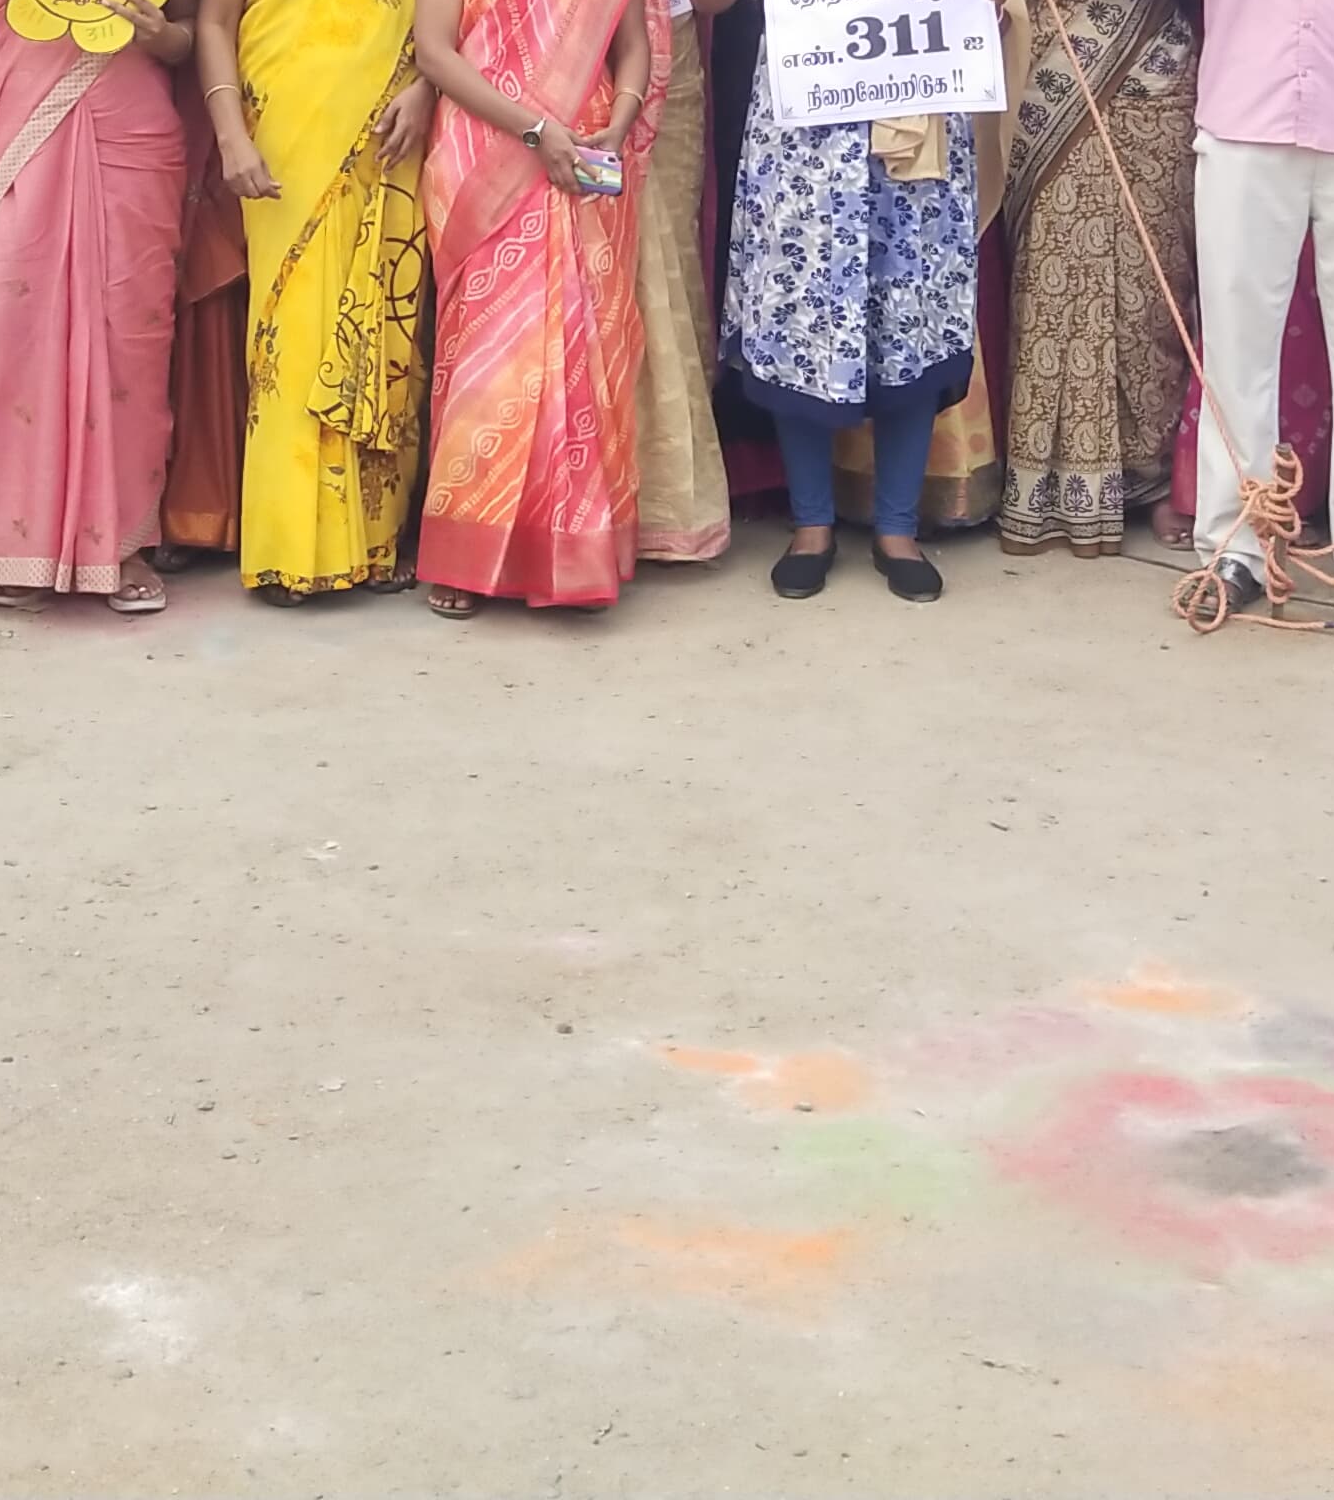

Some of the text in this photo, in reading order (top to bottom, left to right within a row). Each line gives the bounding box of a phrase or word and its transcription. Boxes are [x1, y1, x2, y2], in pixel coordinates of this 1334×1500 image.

[85, 23, 114, 42] 311
[845, 10, 951, 61] 311
[963, 35, 985, 51] ஐ
[807, 73, 948, 113] நிறைவேற்றிடுக
